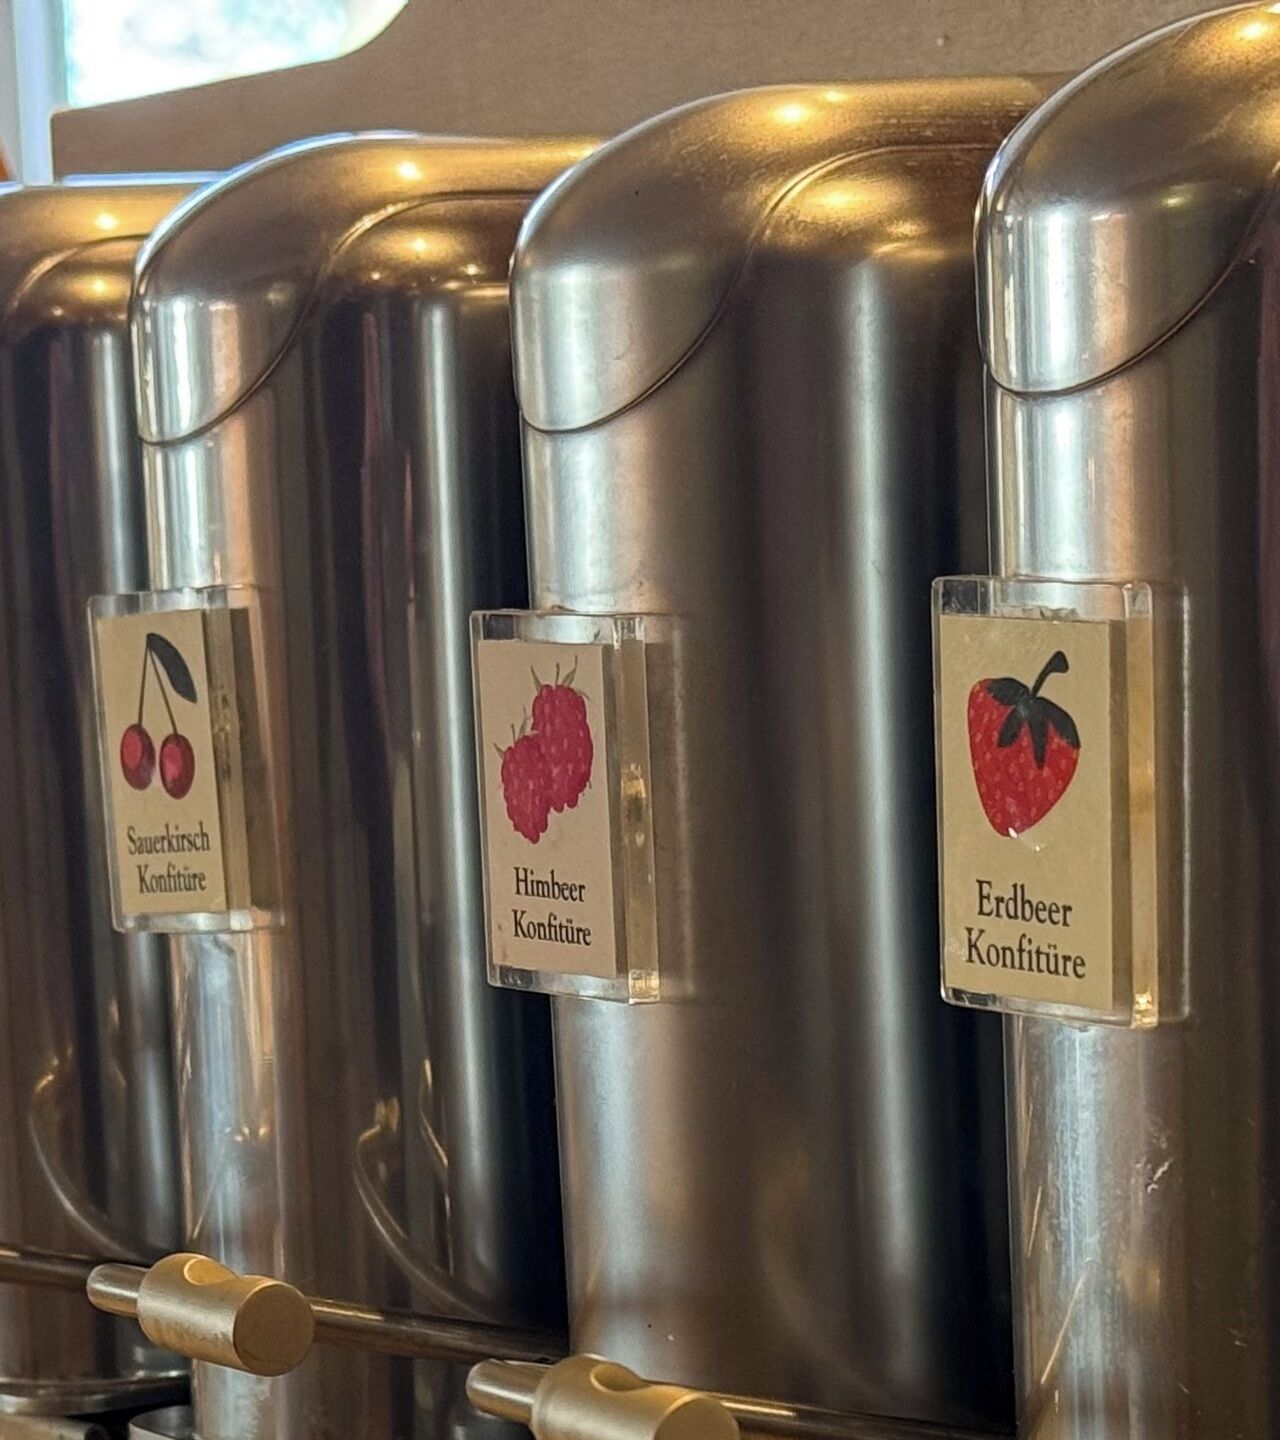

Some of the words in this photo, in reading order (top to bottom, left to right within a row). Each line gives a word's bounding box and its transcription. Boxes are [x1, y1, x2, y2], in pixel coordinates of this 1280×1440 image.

[126, 820, 210, 855] Sauerkirsch
[136, 864, 207, 893] Konfitüre
[513, 866, 586, 902] Himbeer
[975, 879, 1073, 927] Erdbeer
[511, 909, 592, 946] Konfitüre
[965, 926, 1087, 979] Konfitüre
